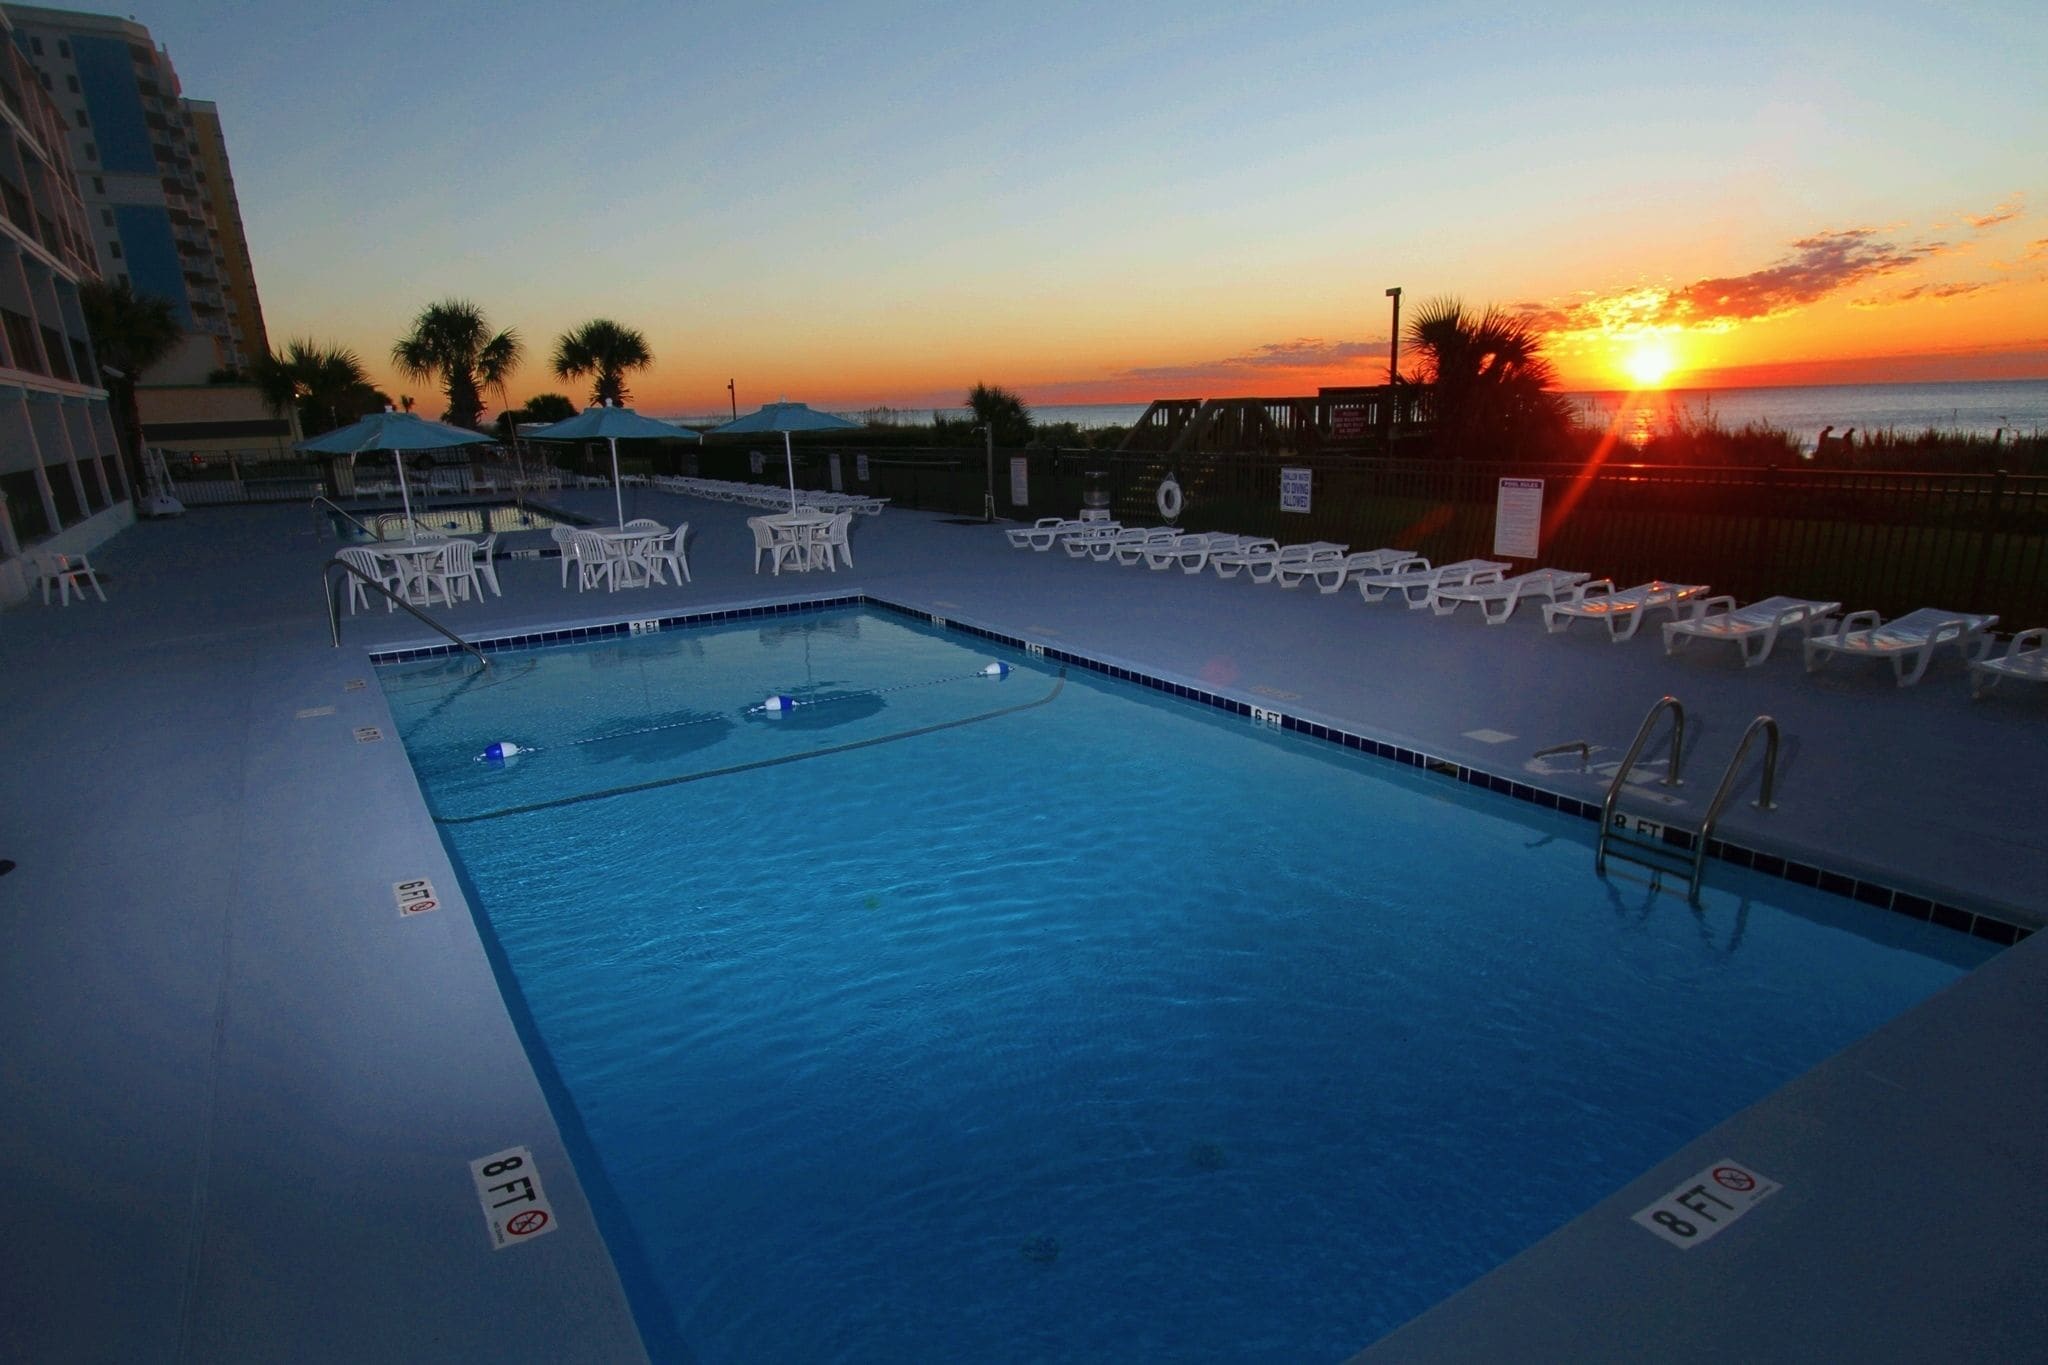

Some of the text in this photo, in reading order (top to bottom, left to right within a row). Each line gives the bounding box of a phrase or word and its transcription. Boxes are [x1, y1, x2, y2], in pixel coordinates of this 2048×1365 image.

[1283, 482, 1309, 495] NO DIVING
[1283, 495, 1308, 507] ALLOWED
[1636, 819, 1661, 839] FT
[398, 880, 430, 902] 6 FT
[483, 1156, 536, 1208] 8 FT
[1652, 1210, 1698, 1237] 8
[1676, 1184, 1735, 1222] FT
